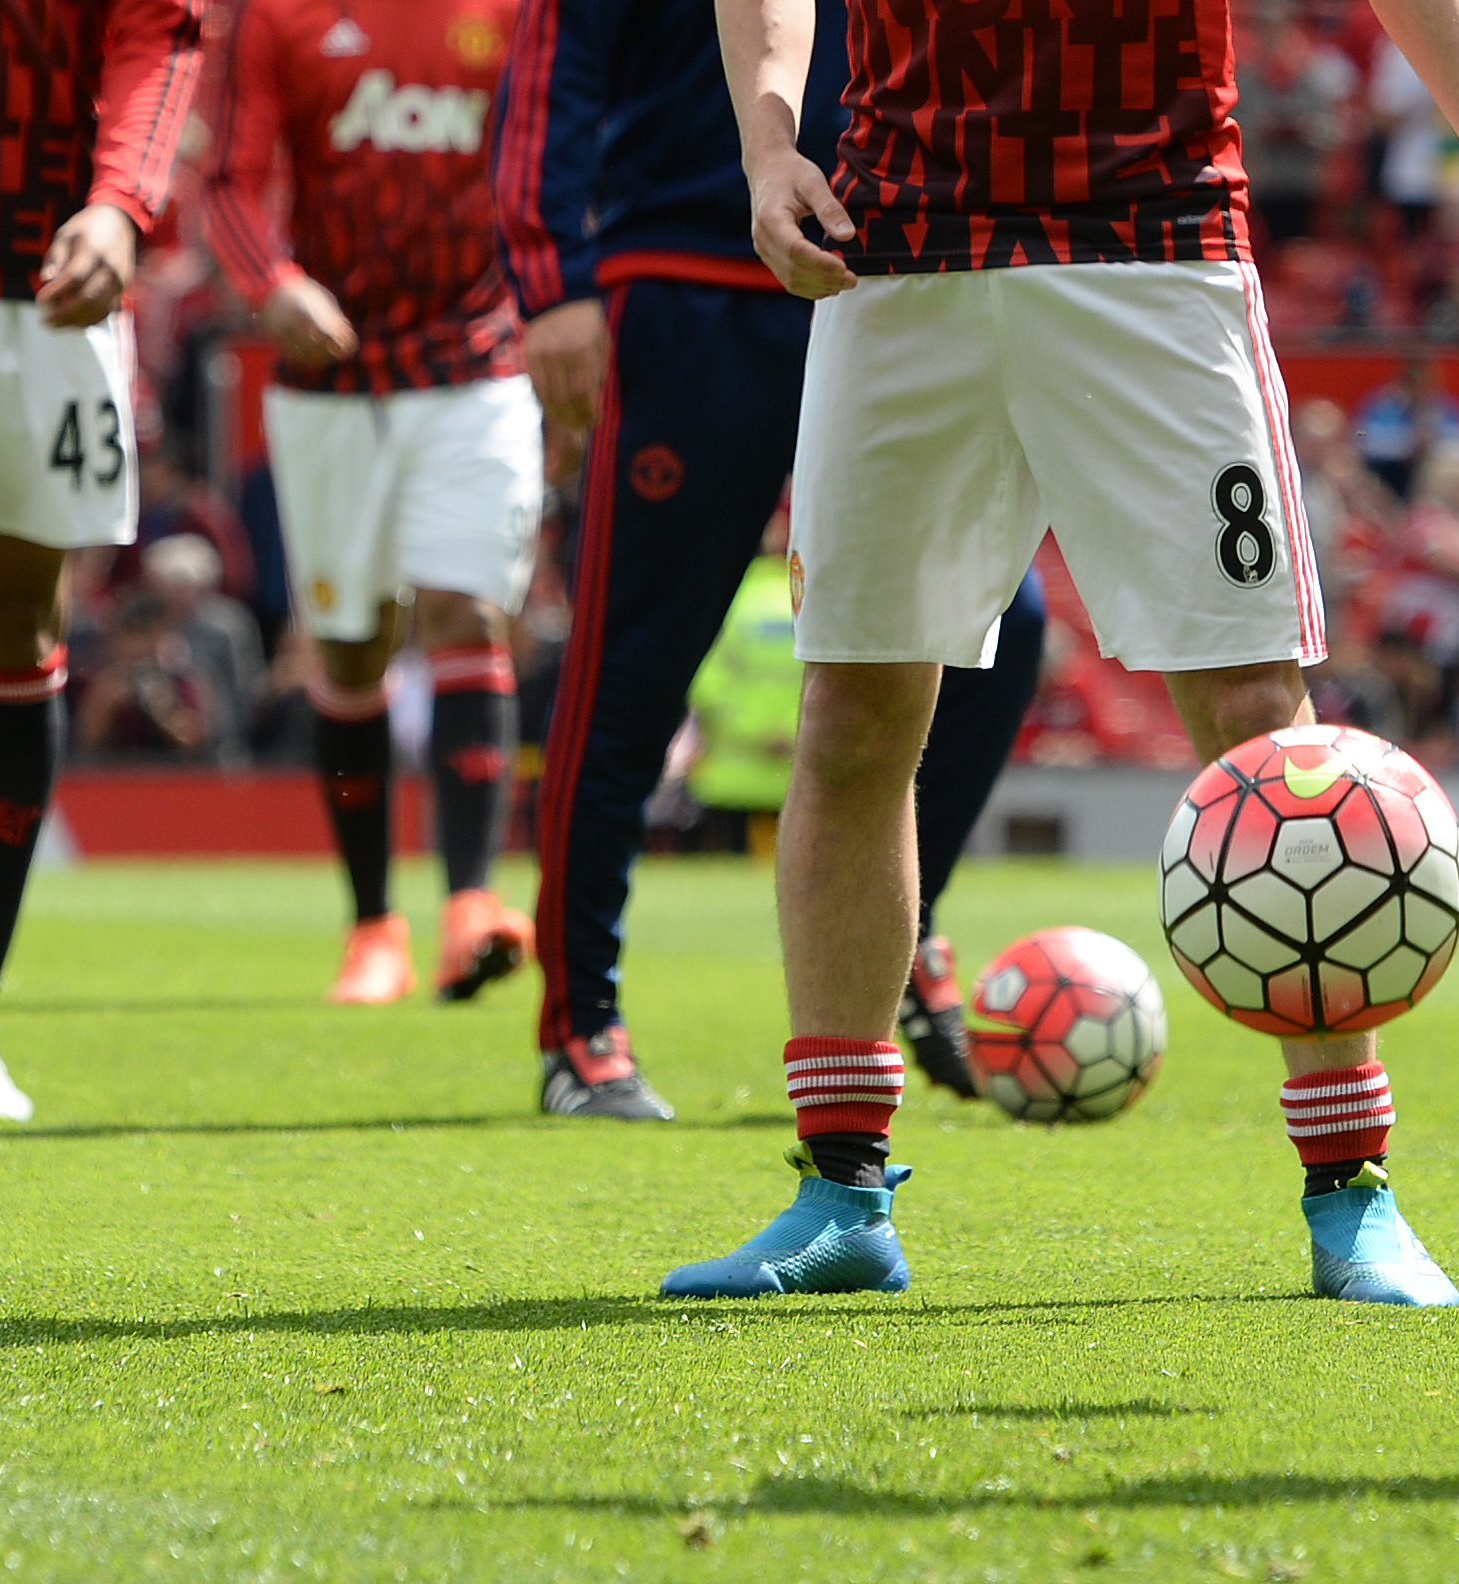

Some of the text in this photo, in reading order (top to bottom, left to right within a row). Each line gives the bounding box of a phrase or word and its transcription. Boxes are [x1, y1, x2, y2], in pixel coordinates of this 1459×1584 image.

[329, 67, 489, 156] AON
[49, 400, 127, 493] 43
[1210, 462, 1277, 589] 8
